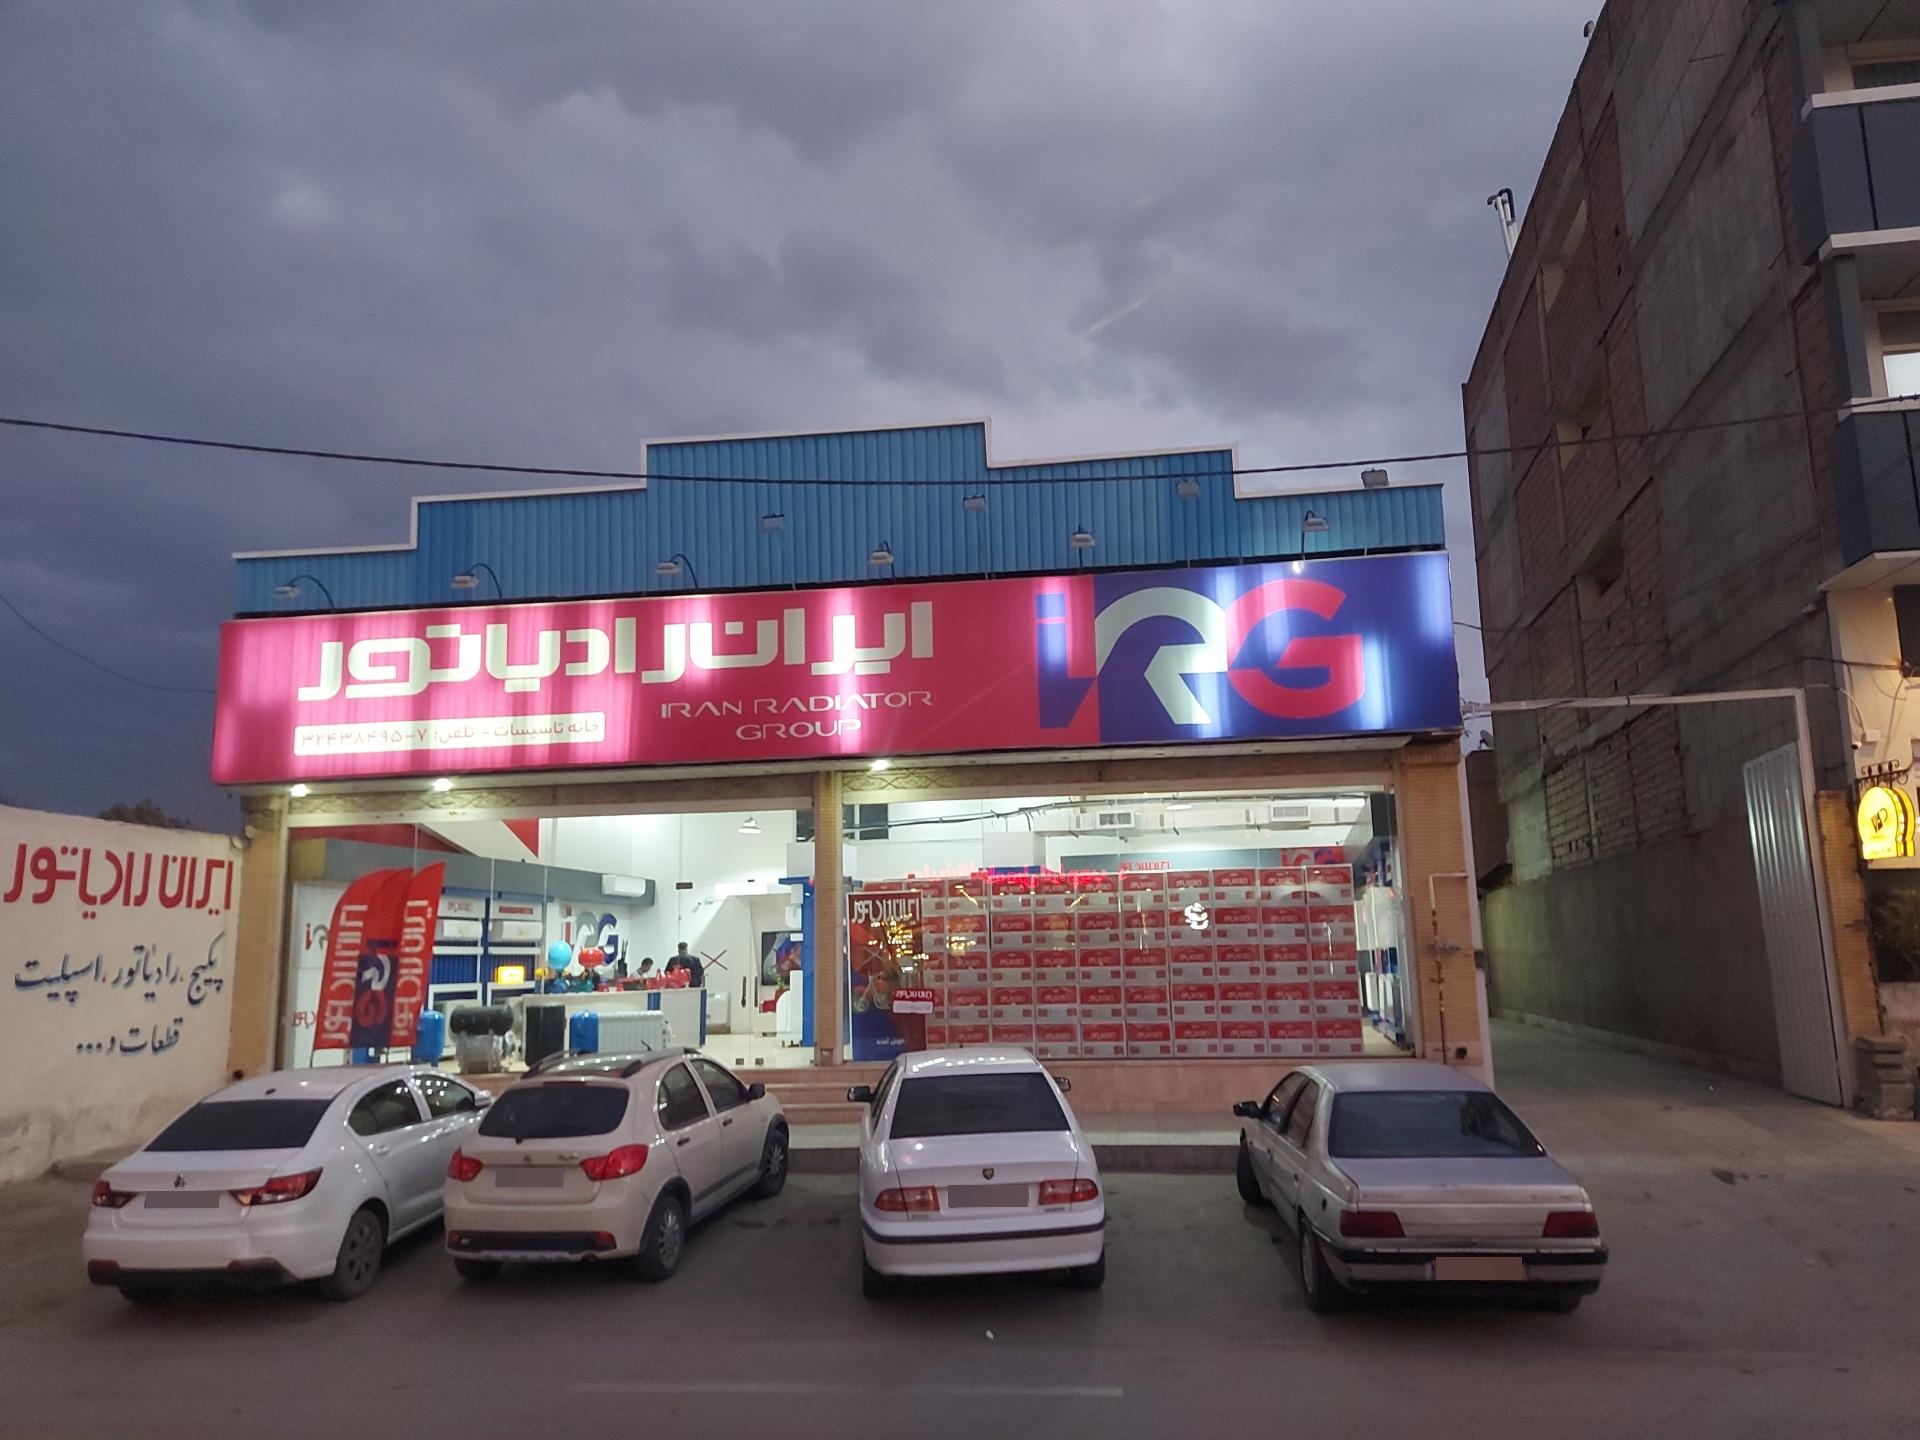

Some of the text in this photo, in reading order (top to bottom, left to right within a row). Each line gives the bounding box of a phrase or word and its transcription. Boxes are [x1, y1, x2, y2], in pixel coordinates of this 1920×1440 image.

[298, 601, 933, 701] ایران رادیاتور
[661, 690, 933, 719] IRAN RADIATOR
[494, 721, 563, 739] تاسیسات
[567, 719, 599, 733] خانه
[736, 719, 862, 741] GROUP
[3, 843, 234, 919] ایران رادیاتور
[120, 1017, 184, 1053] قطعات
